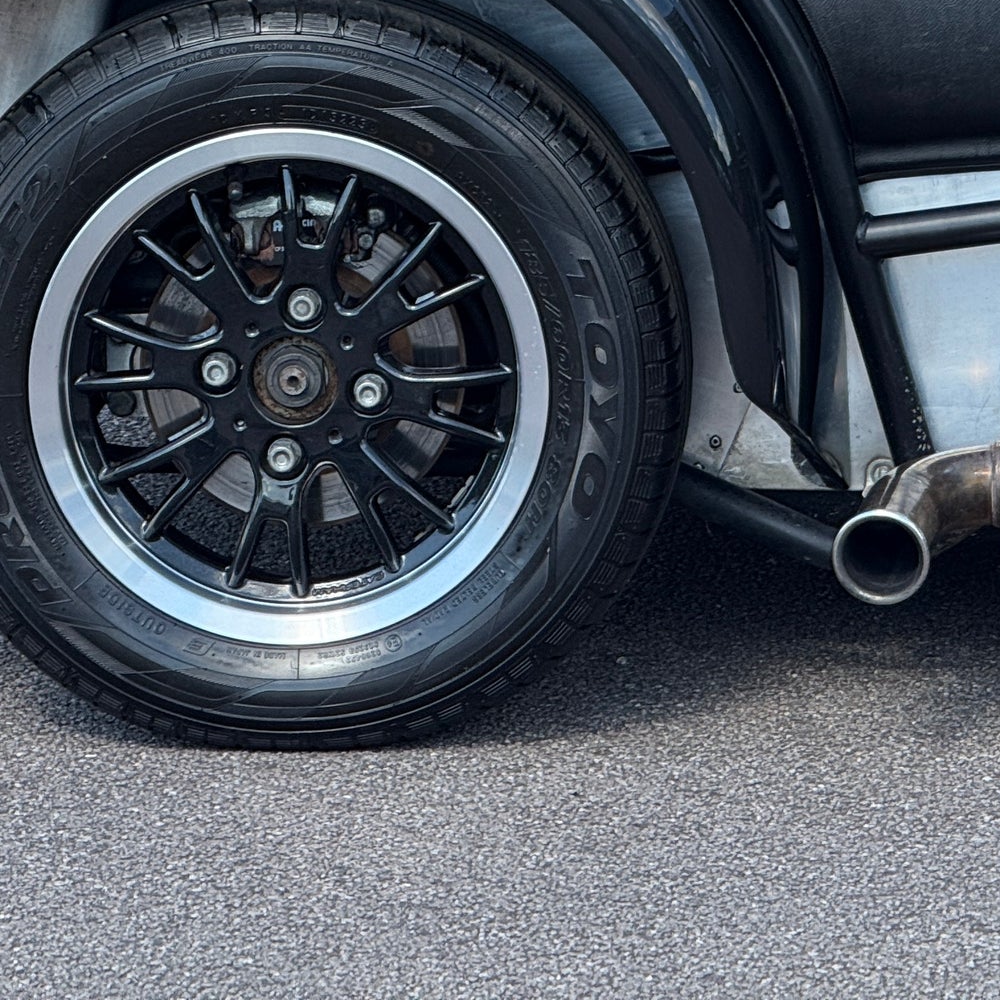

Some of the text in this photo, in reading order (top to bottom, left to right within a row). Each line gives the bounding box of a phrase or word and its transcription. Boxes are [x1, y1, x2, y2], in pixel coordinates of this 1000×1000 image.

[218, 46, 238, 56] 400
[248, 42, 294, 51] TRACTION
[565, 258, 620, 520] TOYO
[98, 583, 167, 636] OUTSIDE
